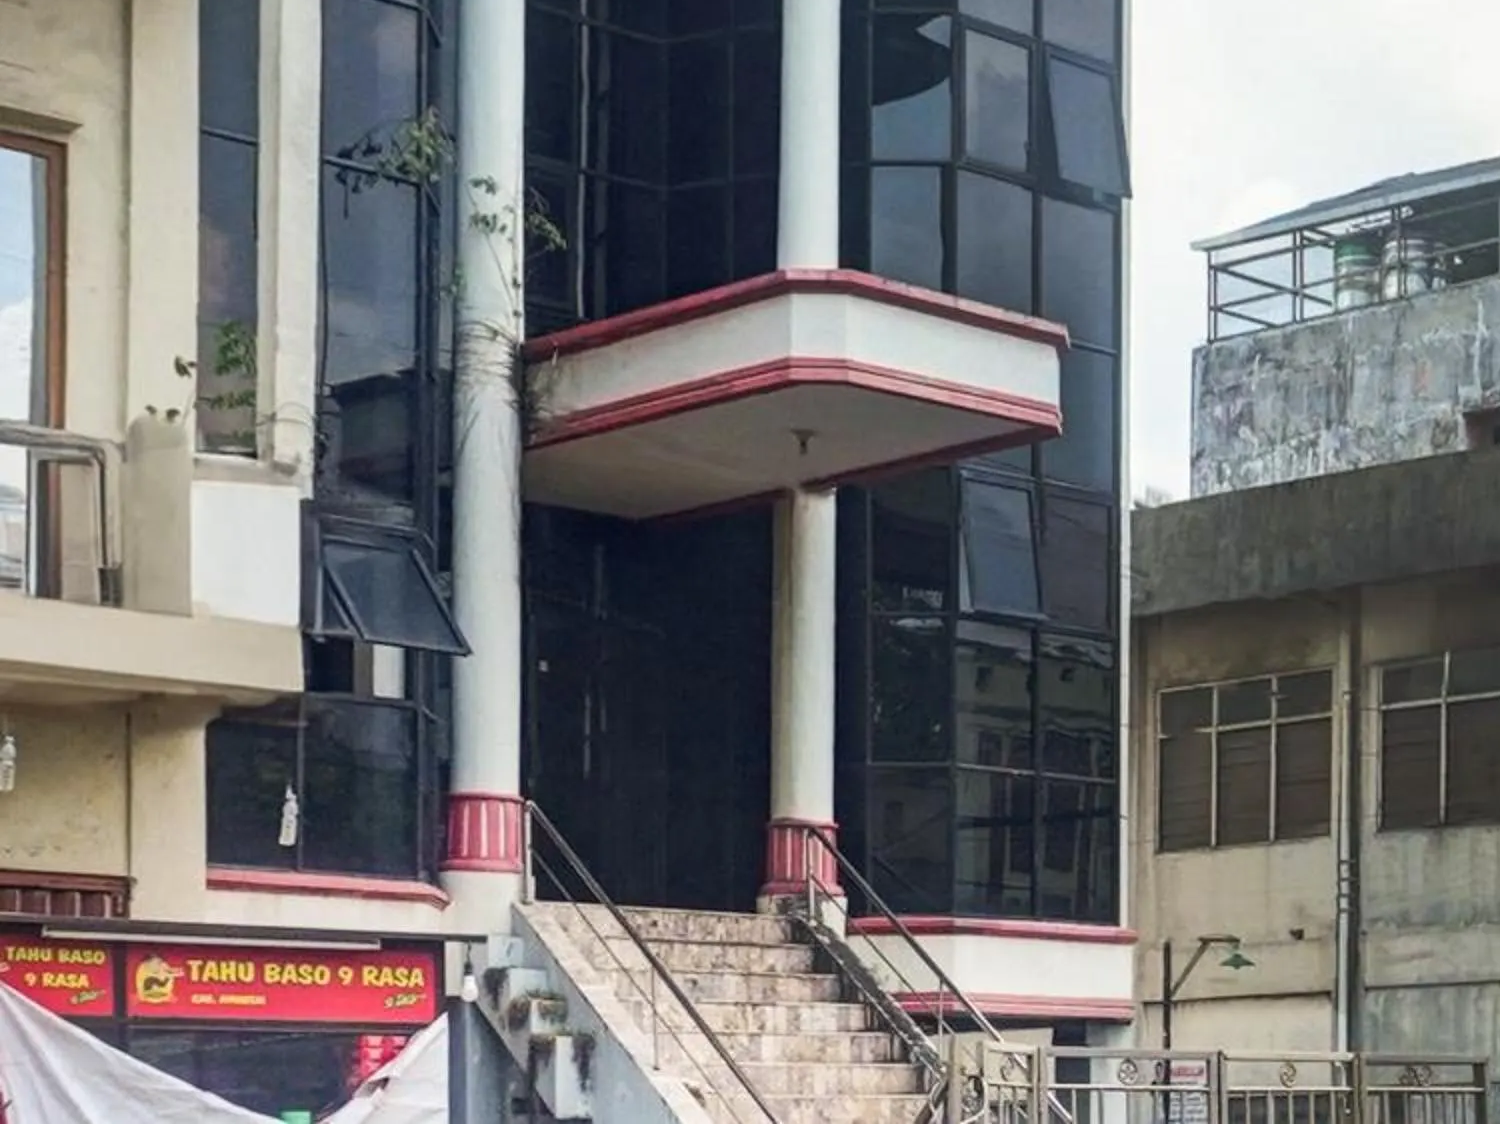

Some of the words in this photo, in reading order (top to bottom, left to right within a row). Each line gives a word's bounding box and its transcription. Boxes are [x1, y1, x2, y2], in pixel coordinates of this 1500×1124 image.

[6, 946, 51, 962] TAHU
[58, 948, 105, 965] BASO
[24, 972, 36, 987] 9
[42, 972, 89, 988] RASA
[187, 960, 255, 983] TAHU
[263, 964, 330, 986] BASO
[338, 969, 353, 985] 9
[362, 966, 425, 988] RASA
